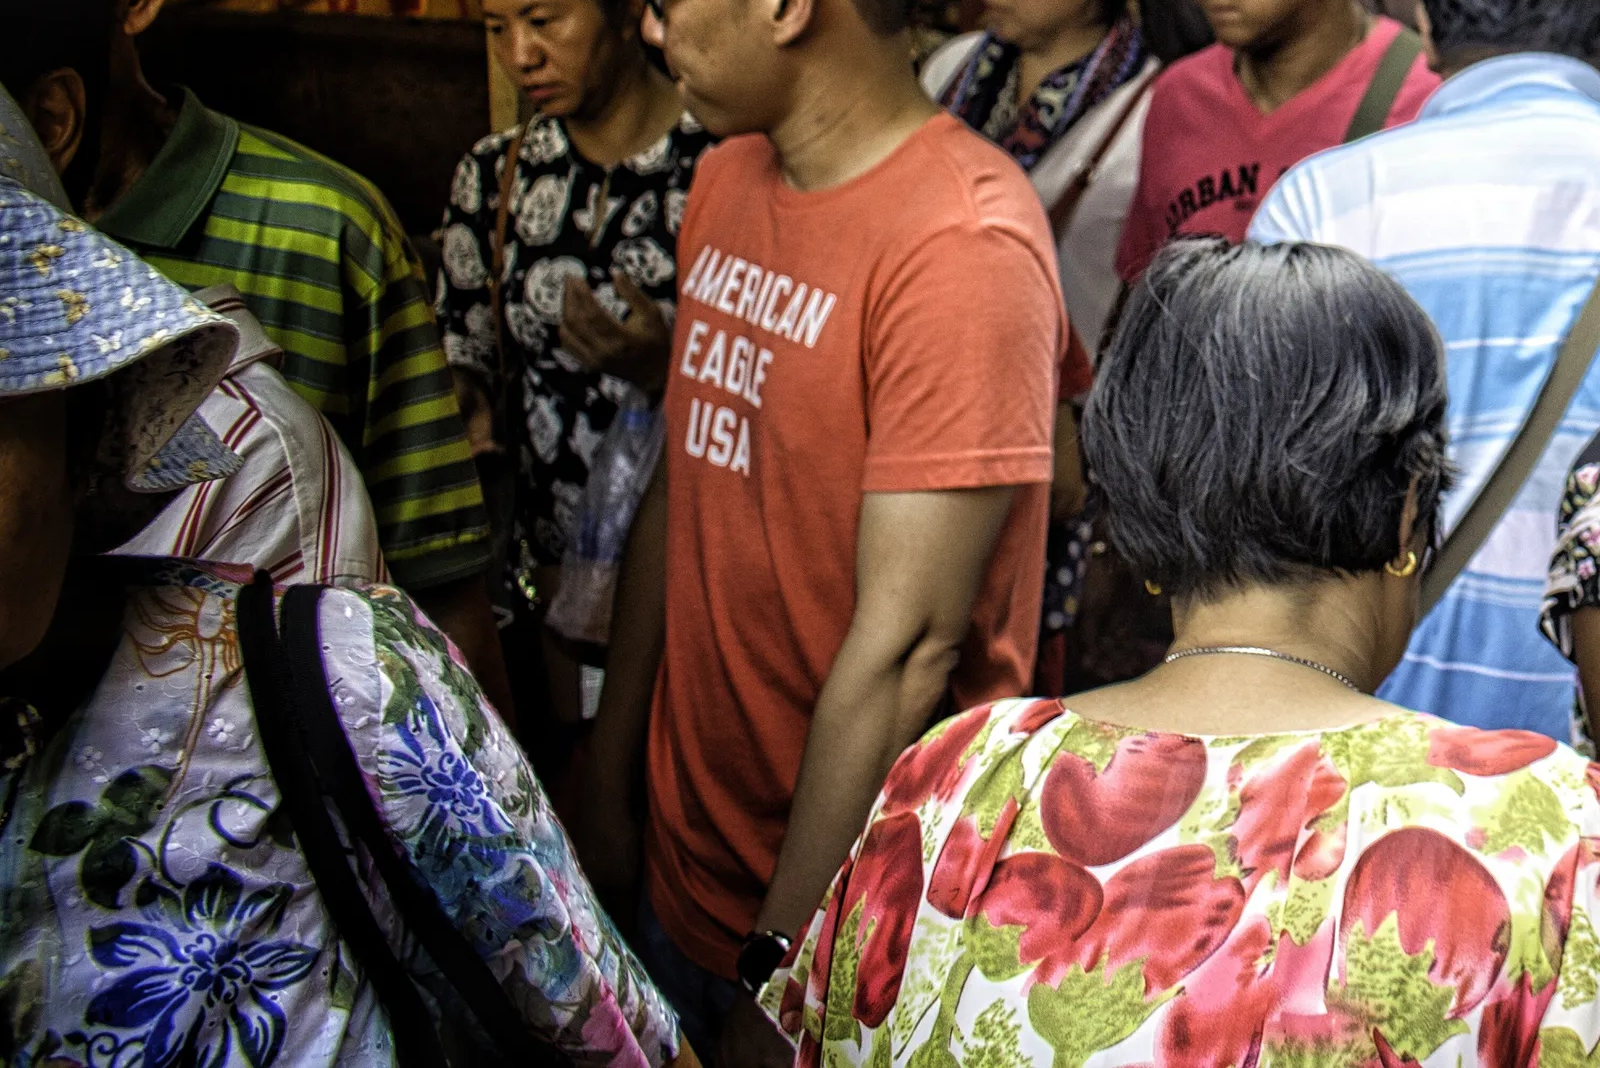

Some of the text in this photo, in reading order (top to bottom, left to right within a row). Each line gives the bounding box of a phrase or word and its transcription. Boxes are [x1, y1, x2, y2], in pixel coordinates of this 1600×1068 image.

[1165, 163, 1259, 236] URBAN
[681, 244, 837, 349] AMERICAN
[680, 320, 774, 409] EAGLE
[685, 398, 750, 477] USA
